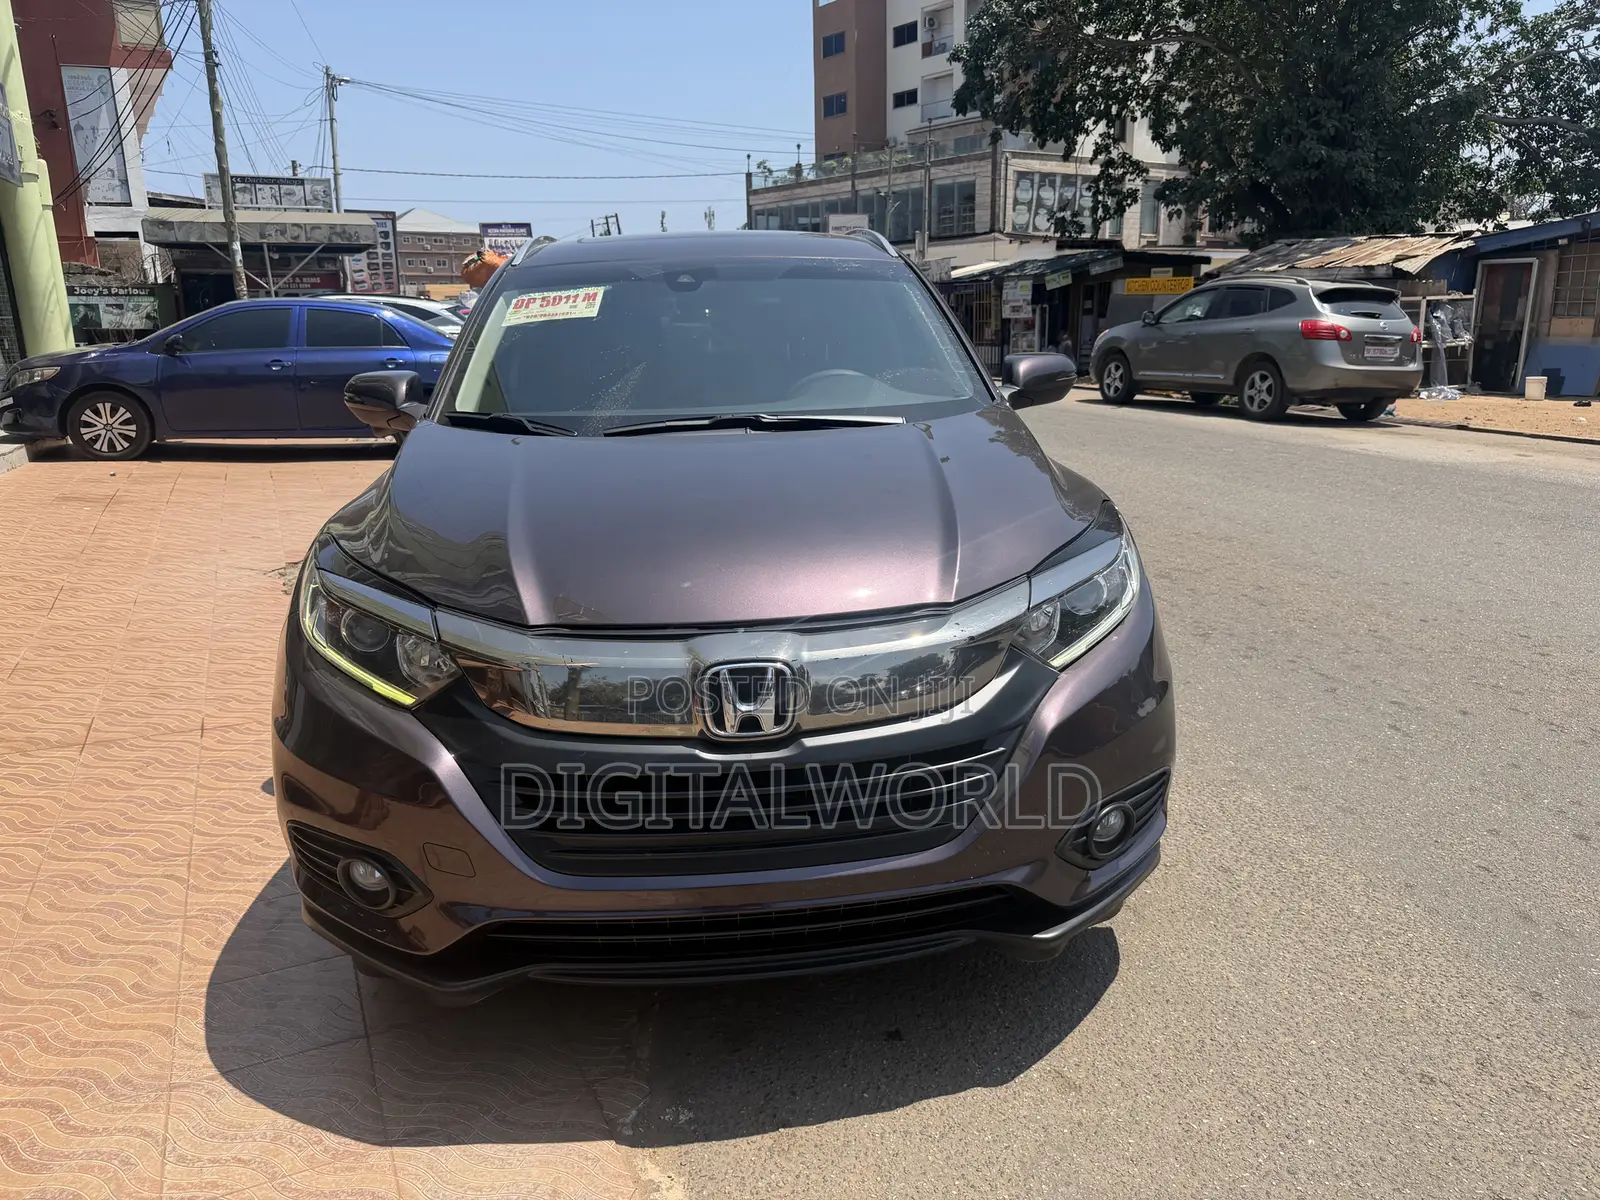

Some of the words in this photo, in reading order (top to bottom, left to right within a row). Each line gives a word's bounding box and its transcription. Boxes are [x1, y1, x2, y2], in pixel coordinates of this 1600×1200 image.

[73, 286, 109, 296] Joey's
[110, 287, 150, 295] Parlour
[581, 291, 599, 303] M
